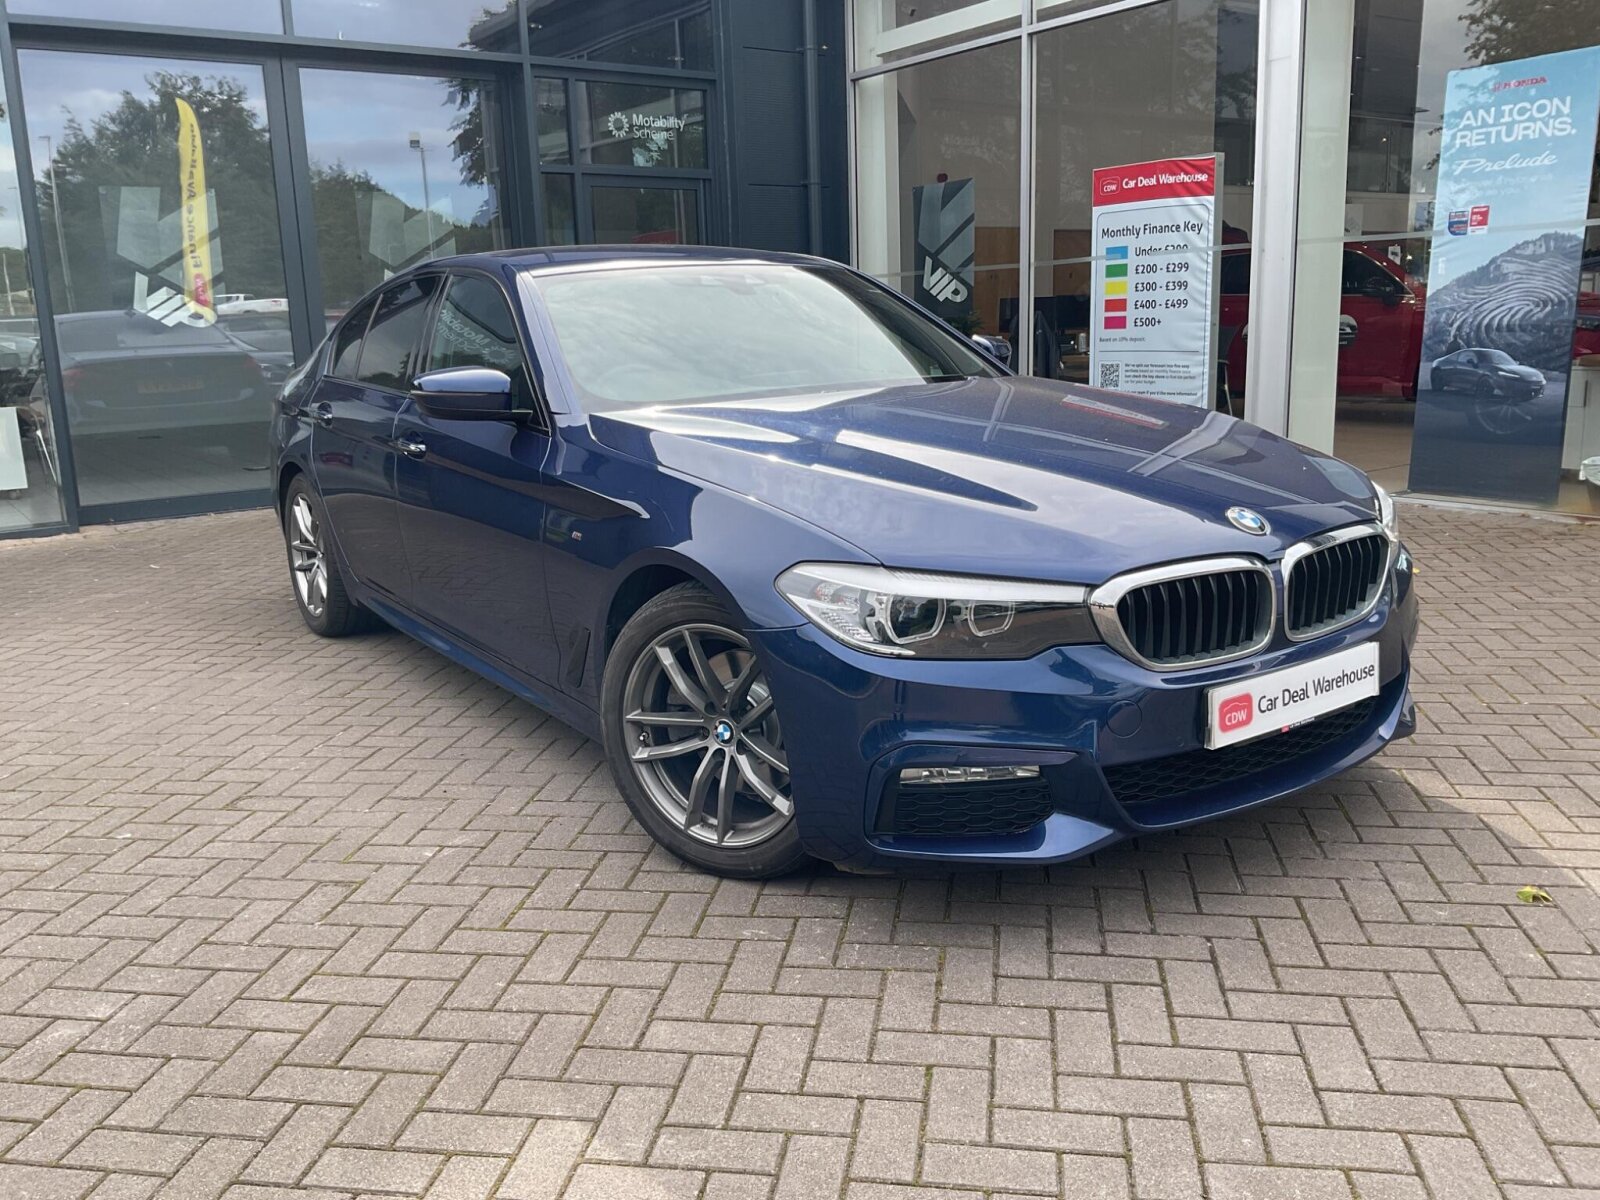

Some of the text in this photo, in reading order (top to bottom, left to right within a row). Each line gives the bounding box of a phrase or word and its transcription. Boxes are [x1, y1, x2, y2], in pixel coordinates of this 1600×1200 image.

[1460, 96, 1571, 128] AN ICON
[632, 113, 685, 132] Motability
[633, 126, 676, 140] Scheme
[1455, 117, 1577, 148] RETURNS.
[1453, 151, 1558, 175] Prelude
[1103, 183, 1117, 192] CDW
[1122, 172, 1208, 189] Car Deal Warehouse
[1101, 221, 1203, 239] Monthly Finance Key
[1135, 263, 1158, 274] £200
[1166, 262, 1189, 273] £299
[922, 255, 968, 303] VIP
[1134, 281, 1157, 292] £300
[1165, 280, 1189, 291] £399
[133, 271, 218, 328] VIP
[1134, 299, 1157, 310] £400
[1164, 298, 1189, 309] £499
[1133, 317, 1162, 328] £500+
[1258, 664, 1375, 713] Car Deal Warehouse
[1225, 709, 1247, 726] CDW
